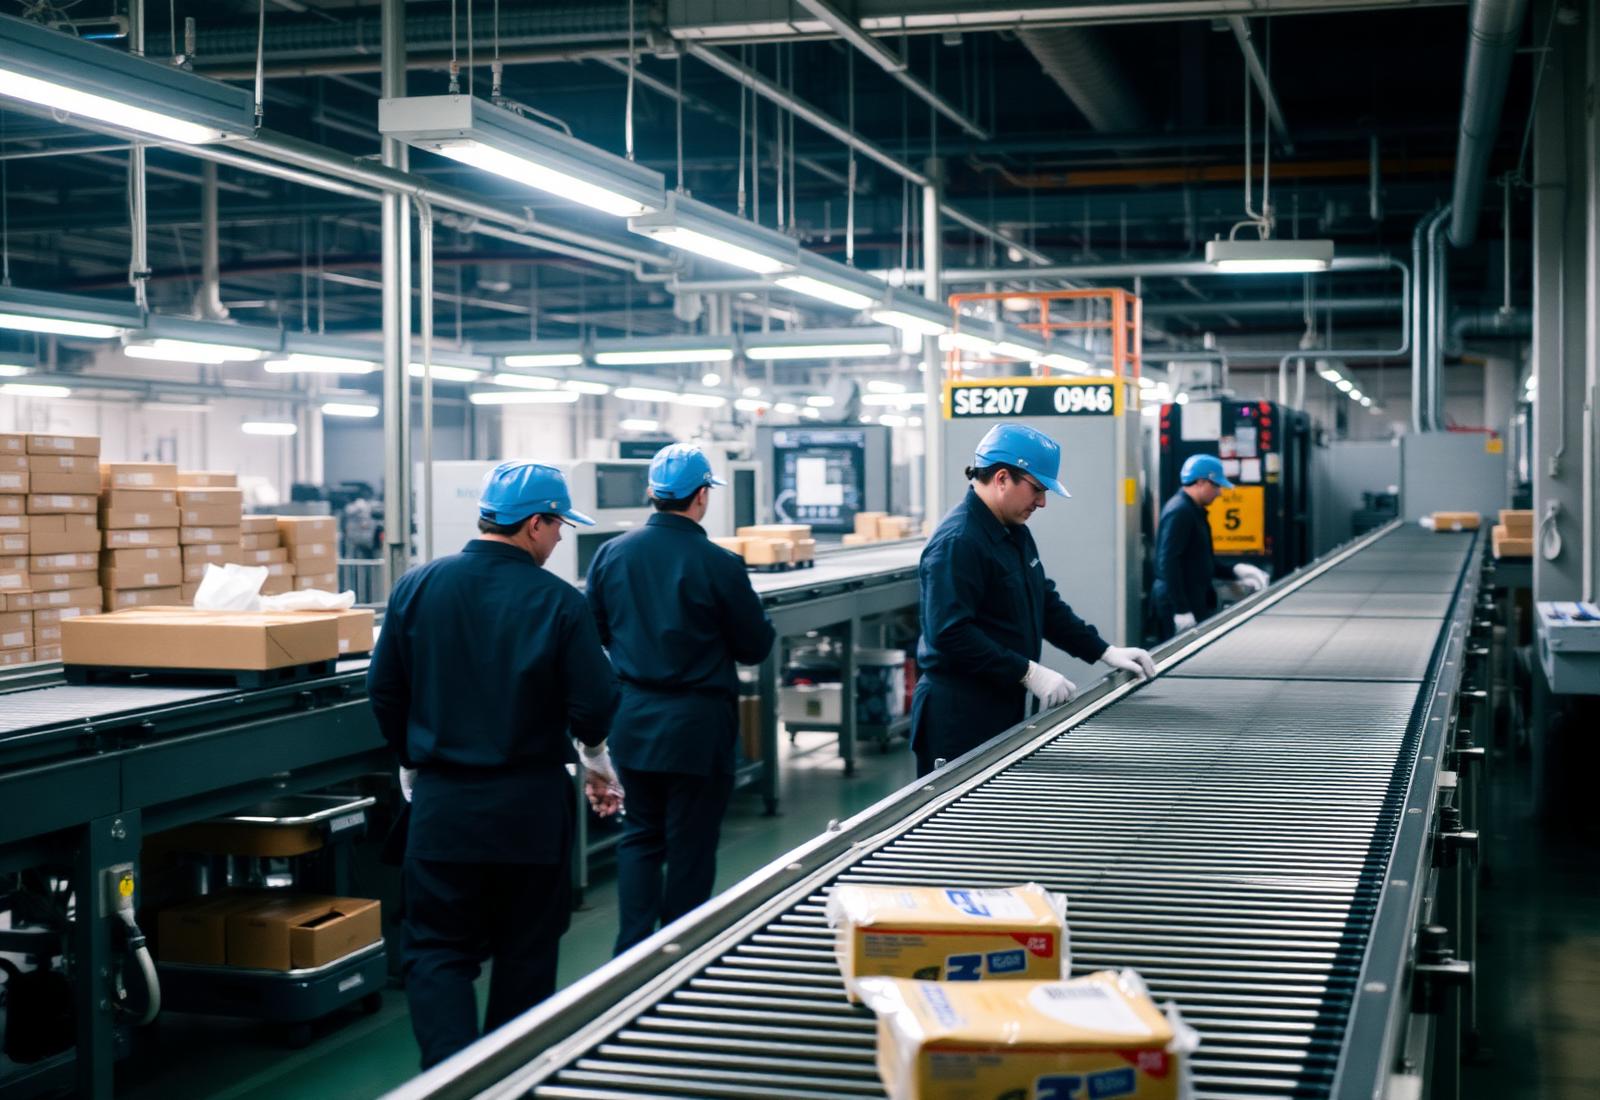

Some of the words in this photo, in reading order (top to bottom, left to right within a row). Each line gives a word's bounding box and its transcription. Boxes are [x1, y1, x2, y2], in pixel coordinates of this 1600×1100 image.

[954, 387, 1028, 415] SE207
[1053, 386, 1112, 413] 0946
[1225, 508, 1241, 531] 5
